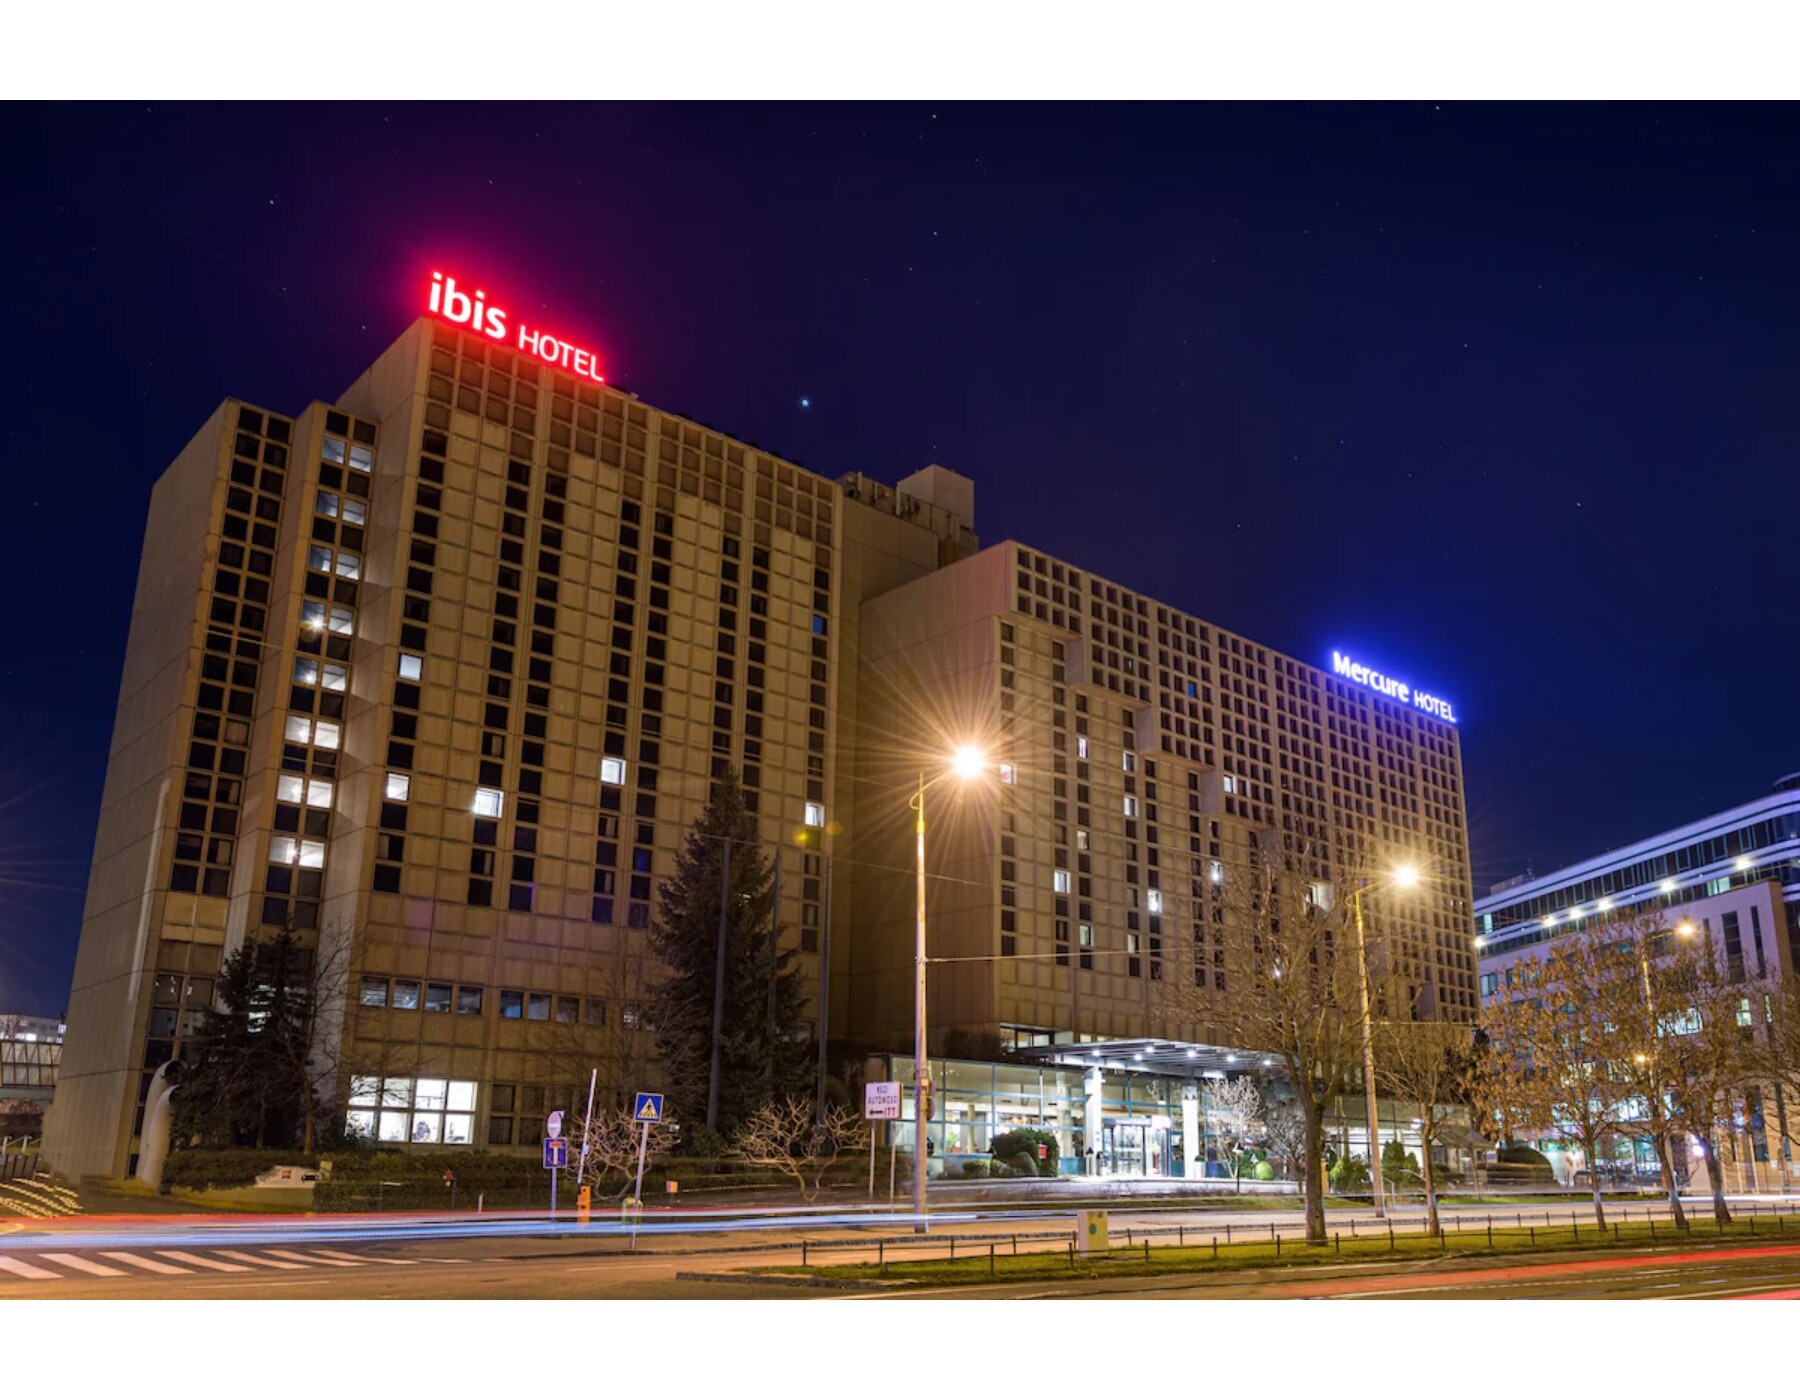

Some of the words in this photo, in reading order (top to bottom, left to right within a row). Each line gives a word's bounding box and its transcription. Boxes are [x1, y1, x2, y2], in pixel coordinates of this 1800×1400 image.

[429, 271, 507, 340] ibis
[518, 325, 604, 382] HOTEL
[1332, 650, 1410, 703] Mercure
[1413, 689, 1457, 723] HOTEL
